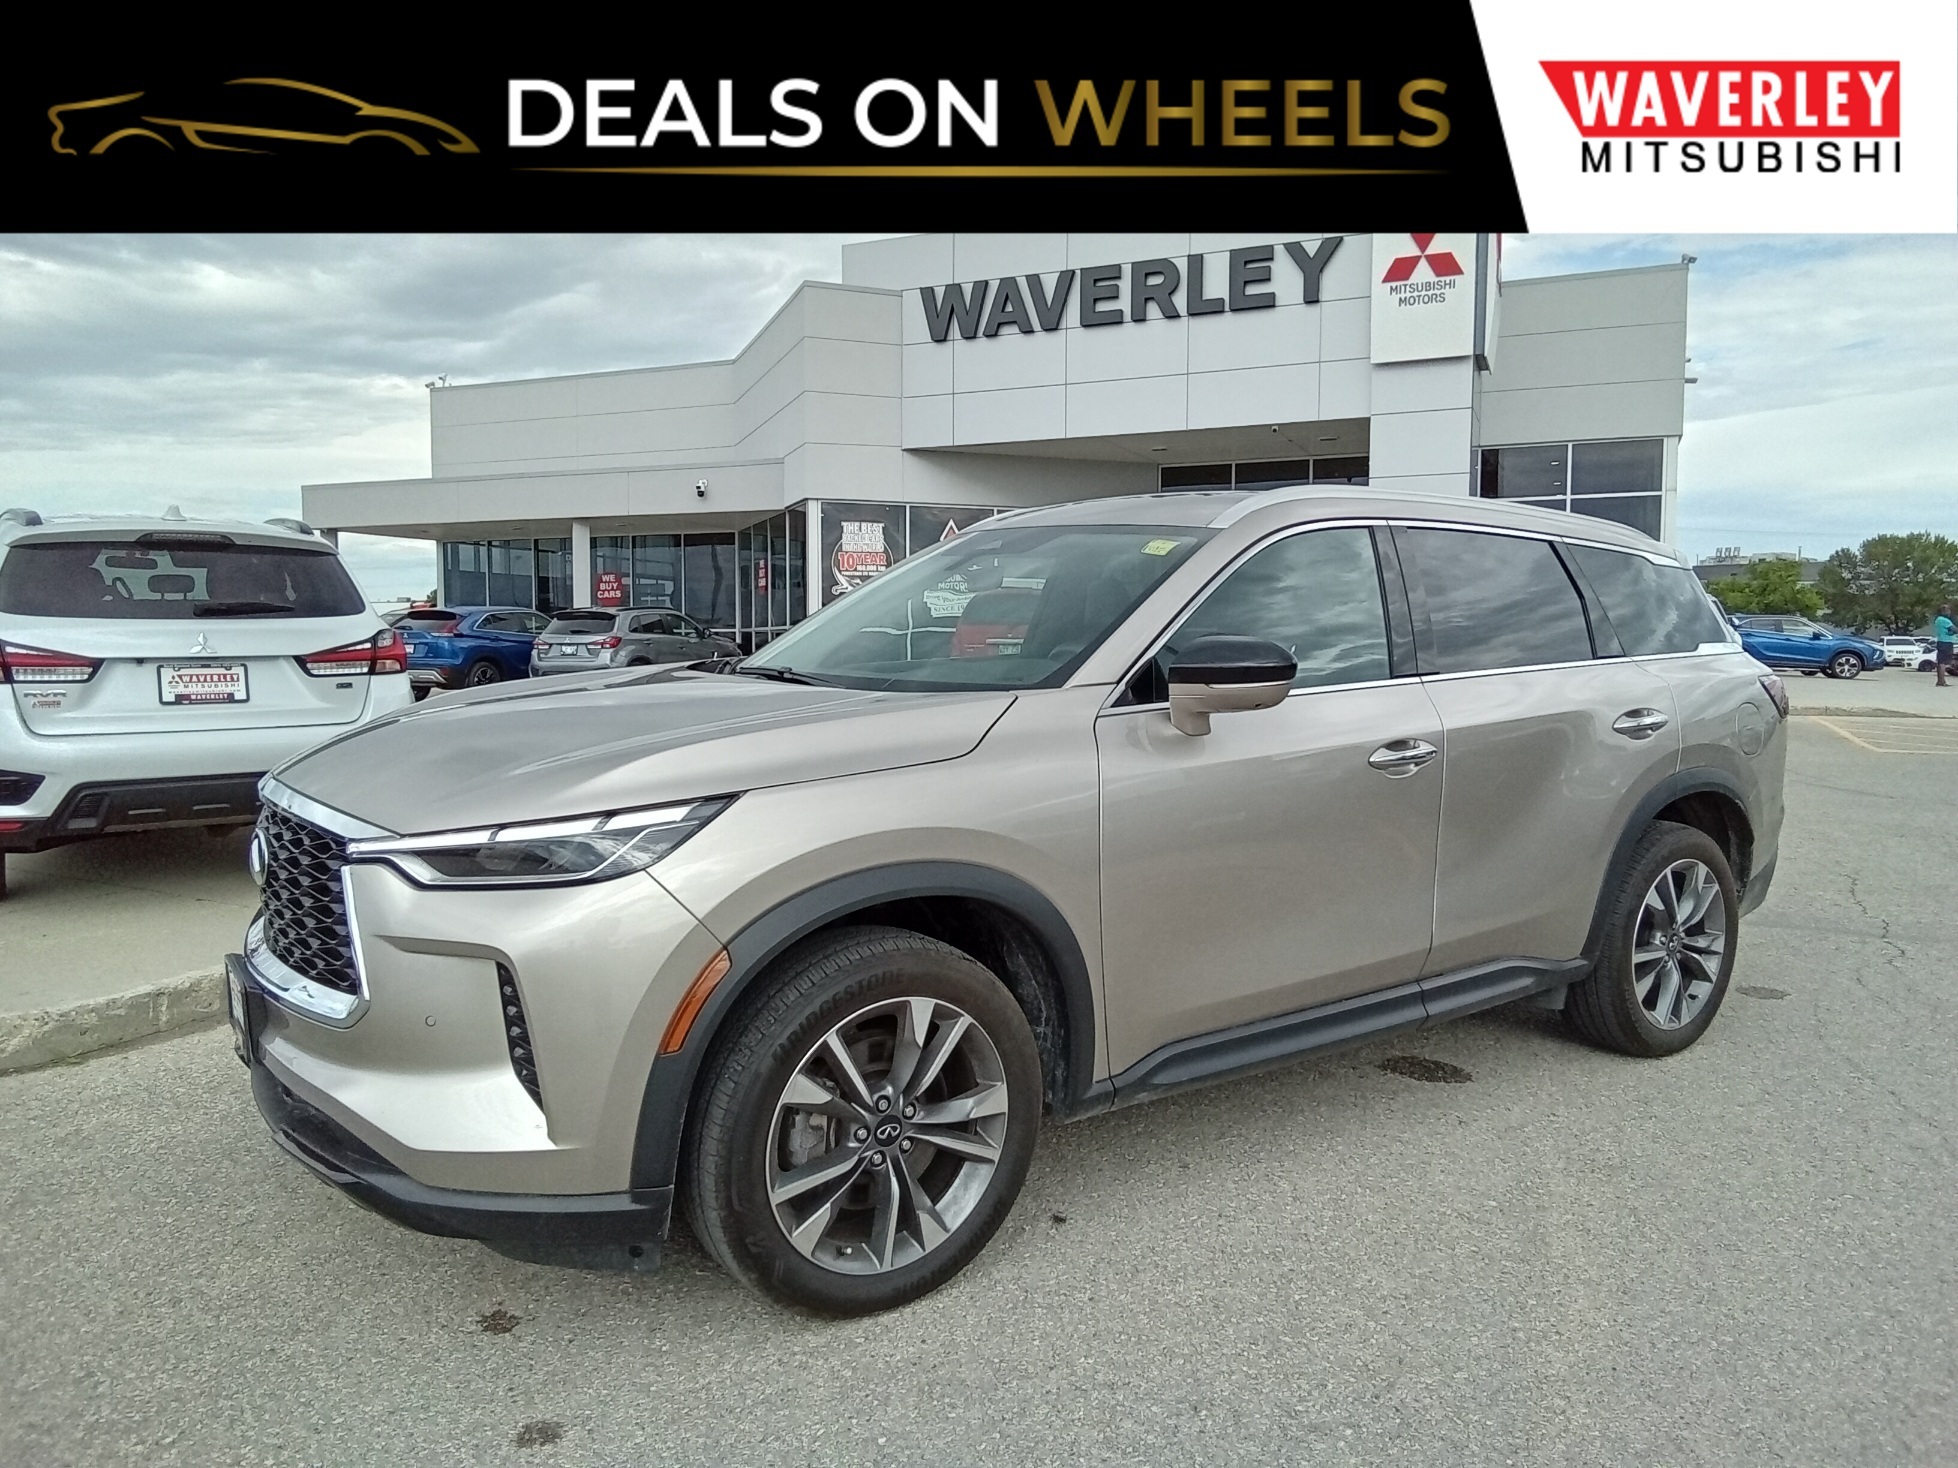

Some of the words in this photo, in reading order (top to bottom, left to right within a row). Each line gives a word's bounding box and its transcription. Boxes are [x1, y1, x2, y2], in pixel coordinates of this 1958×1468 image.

[919, 236, 1344, 342] WAVERLEY
[1389, 278, 1456, 296] MITSUBISHI
[1398, 292, 1446, 307] MOTORS
[841, 521, 860, 534] THE
[860, 521, 885, 534] BEST
[838, 551, 856, 571] 10
[856, 552, 887, 564] YEAR
[601, 574, 616, 582] WE
[600, 582, 618, 590] BUY
[597, 590, 621, 599] CARS
[181, 674, 239, 683] WAVERLEY
